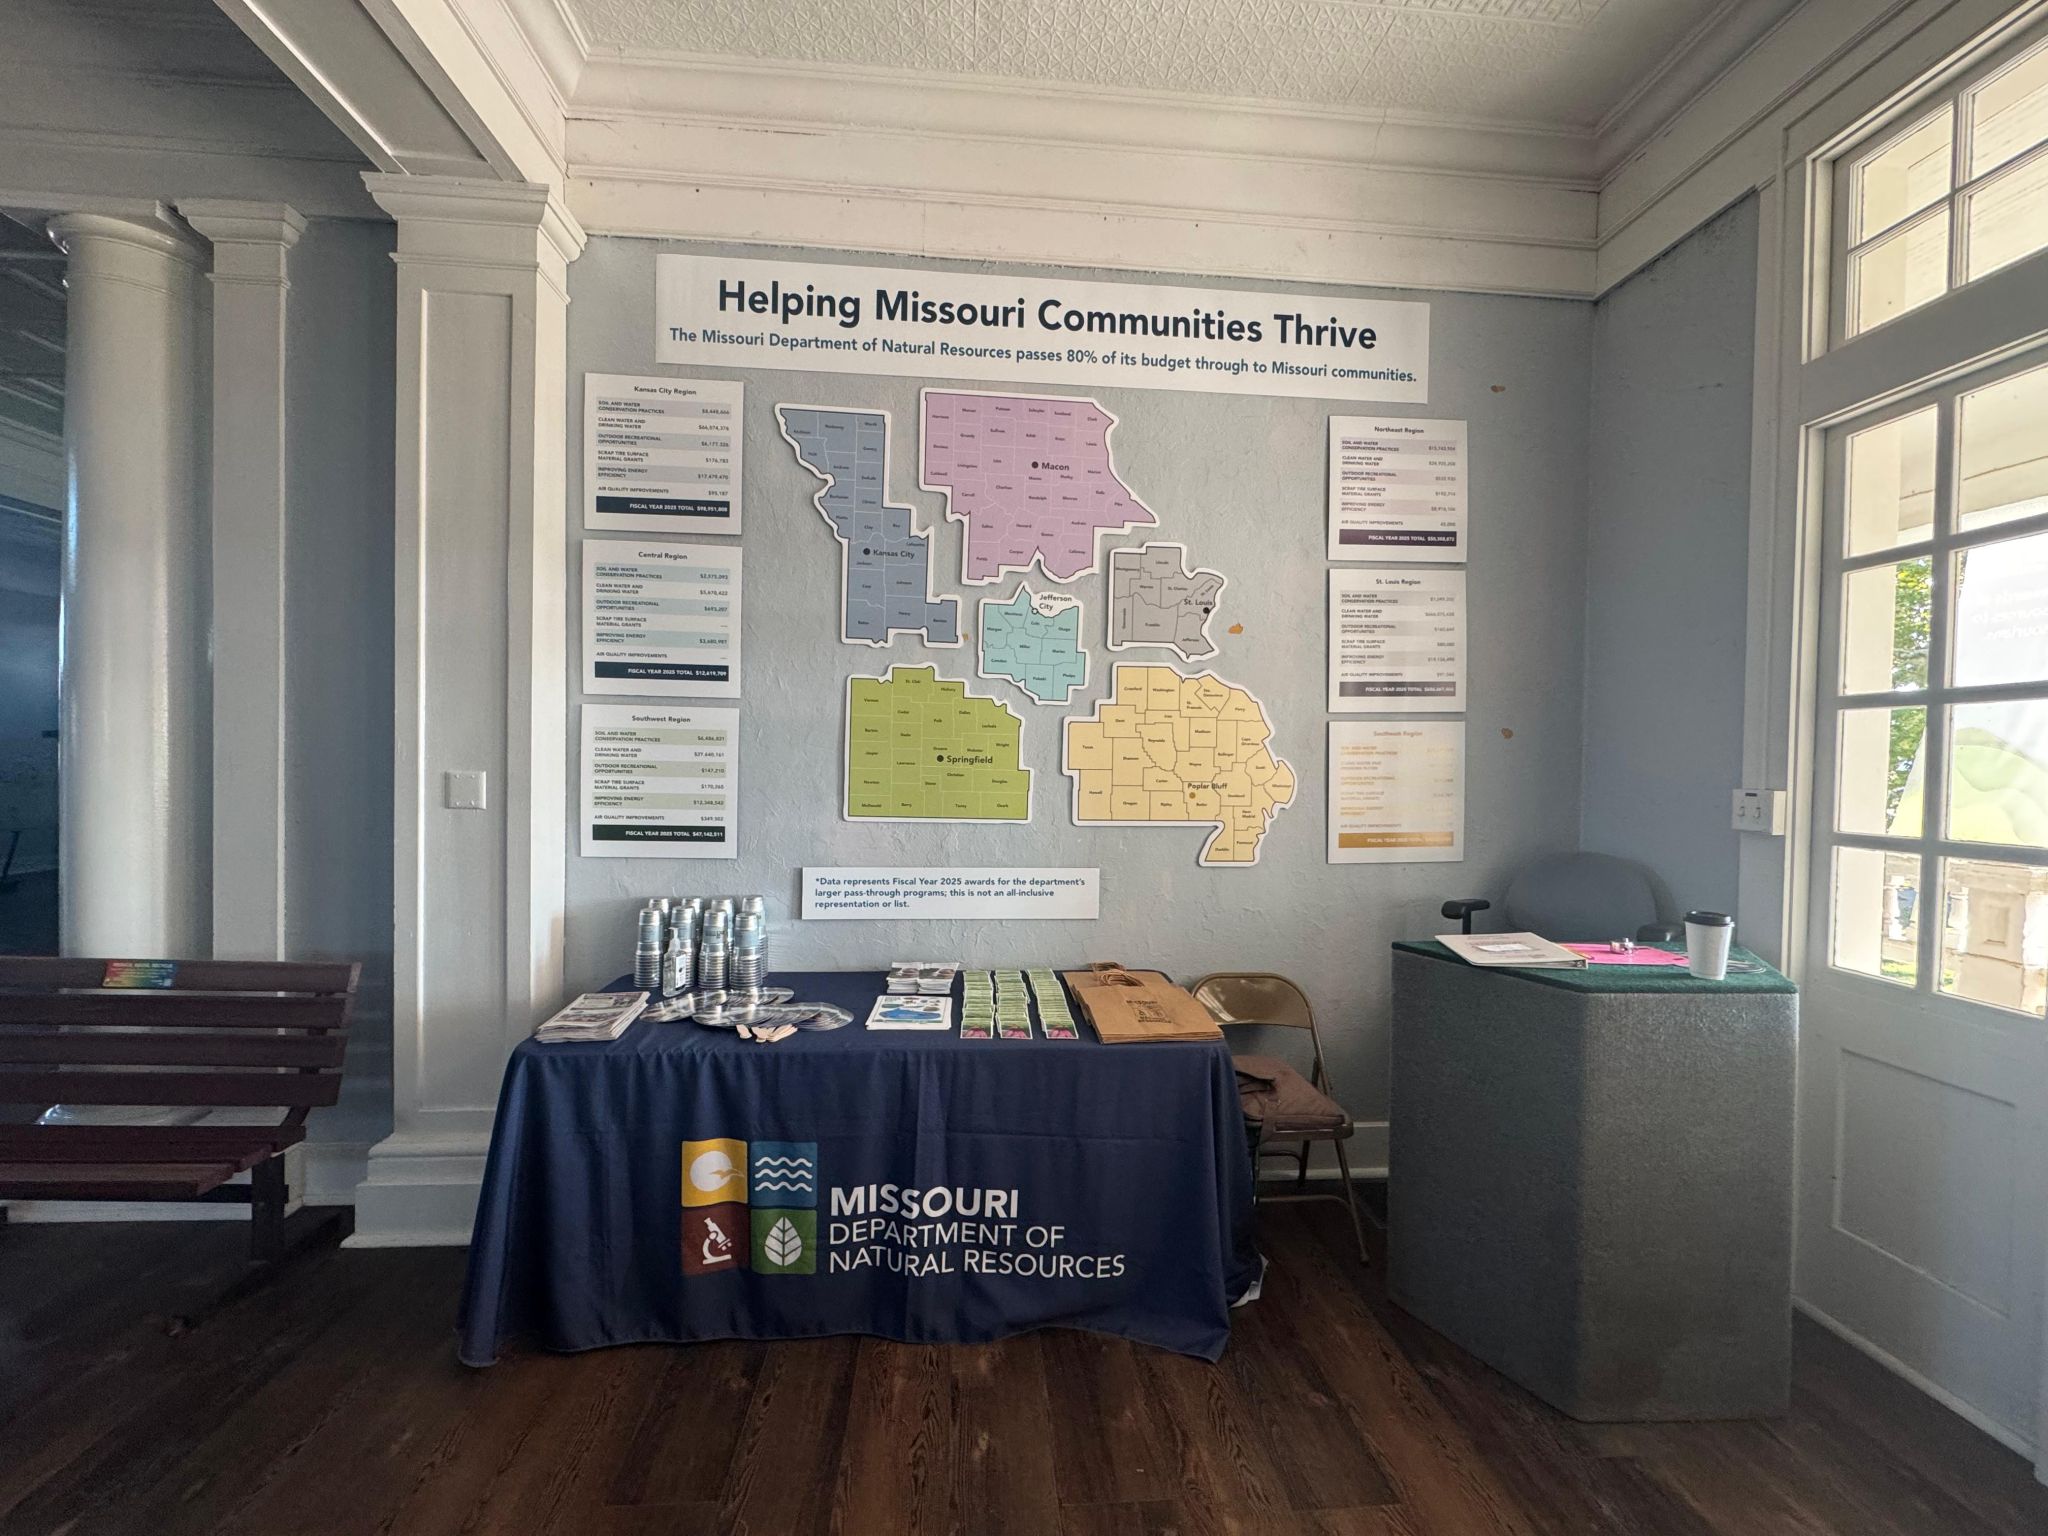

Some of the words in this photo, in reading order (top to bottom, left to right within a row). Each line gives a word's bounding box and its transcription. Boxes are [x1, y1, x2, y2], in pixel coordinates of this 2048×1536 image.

[720, 280, 860, 328] Helping
[876, 290, 1024, 328] Missouri
[1038, 300, 1262, 342] Communities
[1274, 314, 1376, 349] Thrive
[670, 328, 696, 342] The
[703, 330, 764, 346] Missouri
[770, 333, 857, 351] Department
[862, 338, 877, 351] of
[882, 339, 935, 354] Natural
[940, 342, 1011, 358] Resources
[1016, 349, 1062, 363] passes
[1067, 349, 1097, 364] 80%
[1102, 351, 1116, 364] of
[1121, 352, 1136, 366] its
[1142, 353, 1191, 372] budget
[1195, 356, 1248, 375] through
[1253, 362, 1267, 373] to
[1272, 361, 1327, 376] Missouri
[1332, 367, 1416, 382] communities.
[659, 387, 672, 396] City
[674, 388, 697, 397] Region
[1042, 462, 1070, 471] Macon
[900, 550, 915, 560] City
[1040, 594, 1072, 603] Jefferson
[1039, 602, 1054, 612] City
[947, 755, 992, 765] Springfield
[844, 878, 890, 888] represents
[997, 877, 1010, 885] for
[816, 889, 842, 898] larger
[844, 888, 900, 898] pass-through
[903, 890, 947, 898] programs;
[815, 900, 880, 910] representation
[832, 1184, 1018, 1218] MISSOURI
[830, 1218, 1019, 1248] DEPARTMENT
[1026, 1226, 1064, 1248] OF
[830, 1247, 954, 1277] NATURAL
[964, 1250, 1125, 1278] RESOURCES
